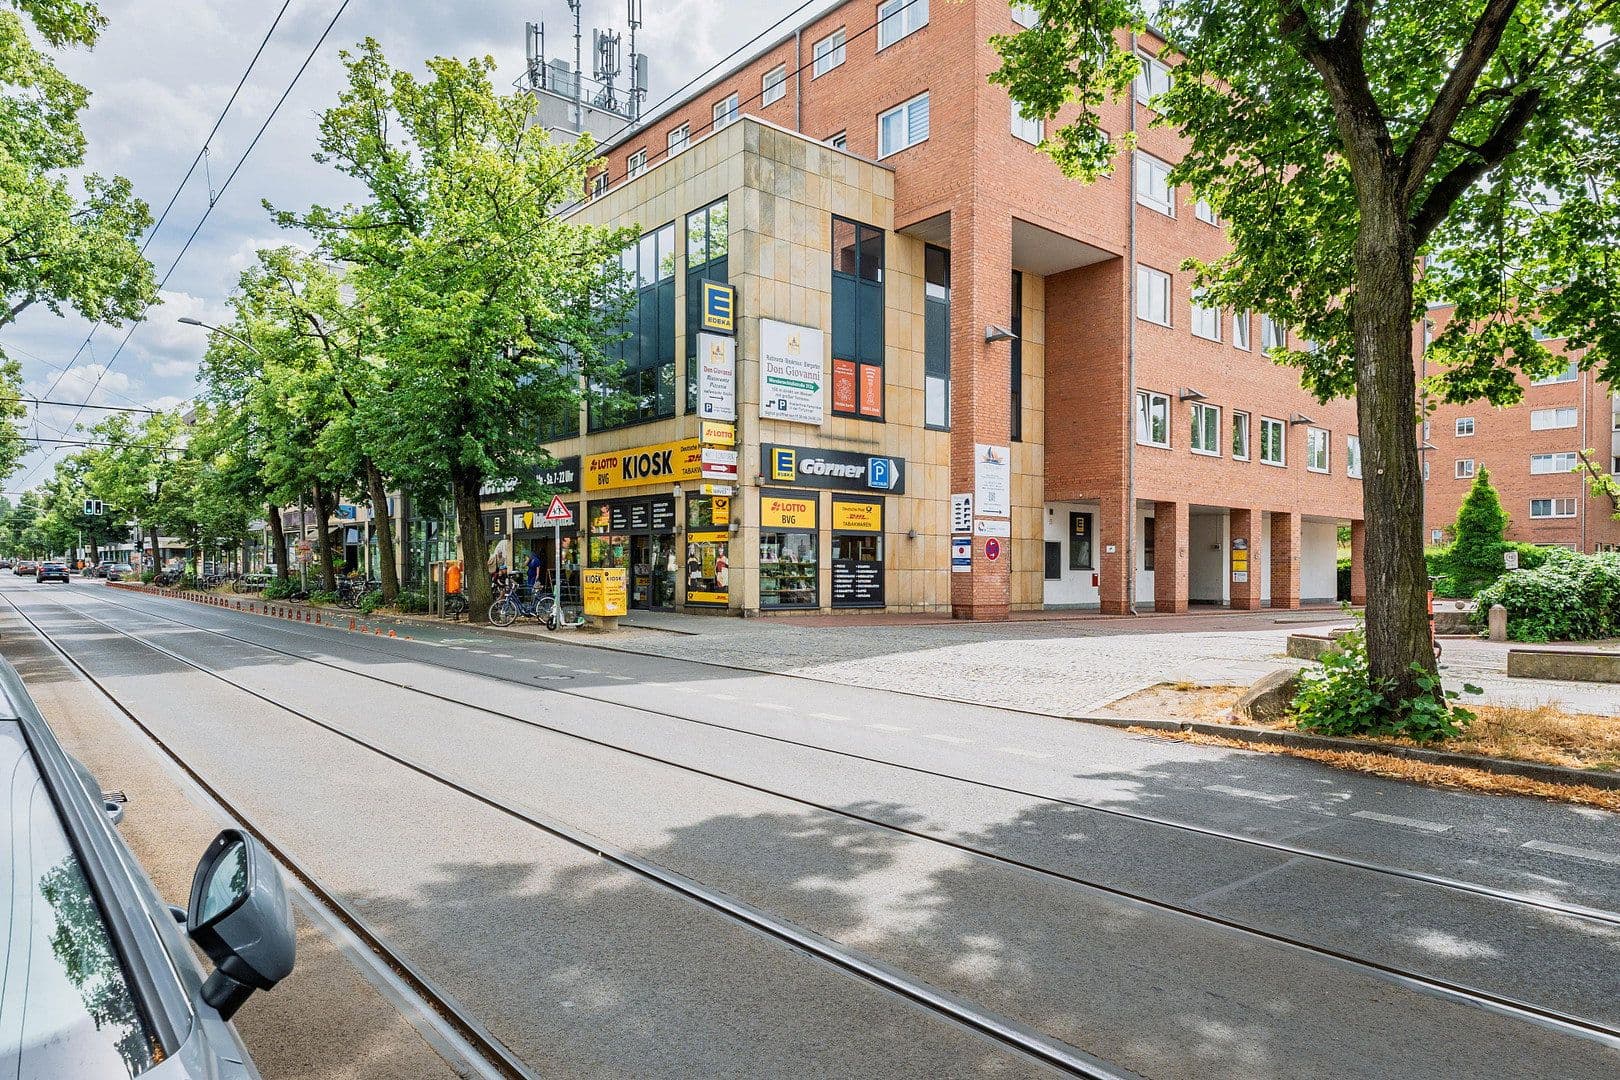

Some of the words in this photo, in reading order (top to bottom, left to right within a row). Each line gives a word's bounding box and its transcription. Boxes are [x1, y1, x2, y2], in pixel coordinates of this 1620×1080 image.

[708, 316, 731, 326] EDEKA
[766, 362, 783, 374] Don
[786, 365, 820, 381] Giovanni
[713, 429, 733, 439] LOTTO
[598, 456, 618, 470] LOTTO
[622, 449, 673, 480] KIOSK
[800, 458, 866, 479] Görner
[597, 472, 610, 485] BVG
[781, 502, 806, 513] LOTTO
[782, 514, 796, 525] BVG
[585, 574, 602, 584] KIOSK
